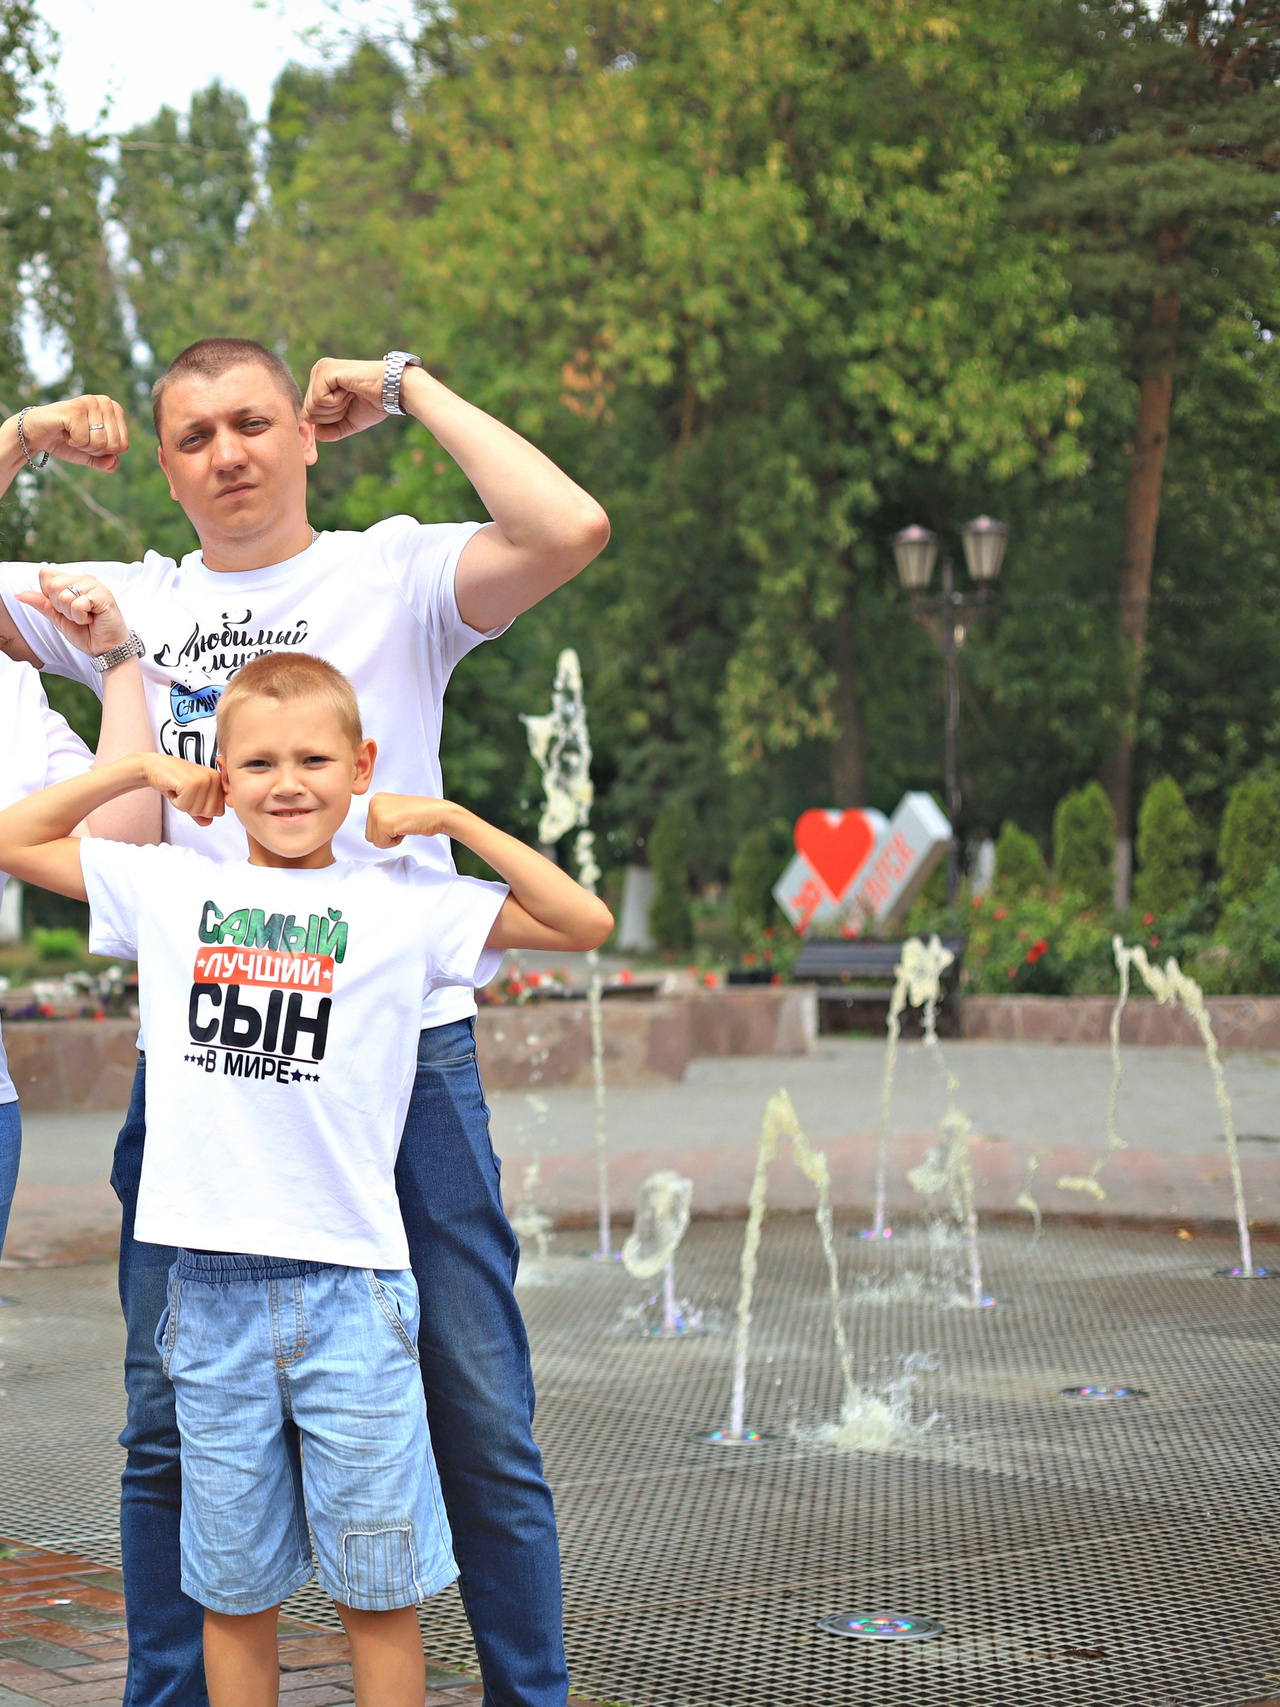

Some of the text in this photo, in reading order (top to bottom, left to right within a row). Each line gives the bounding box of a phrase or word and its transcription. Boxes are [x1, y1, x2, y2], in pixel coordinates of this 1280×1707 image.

[153, 609, 308, 667] Любимый
[176, 689, 221, 717] САМЫ
[198, 900, 349, 964] САМЫЙ
[203, 952, 321, 987] ЛУЧШИЙ
[188, 982, 332, 1061] СЫН
[204, 1049, 291, 1084] В МИРЕ
